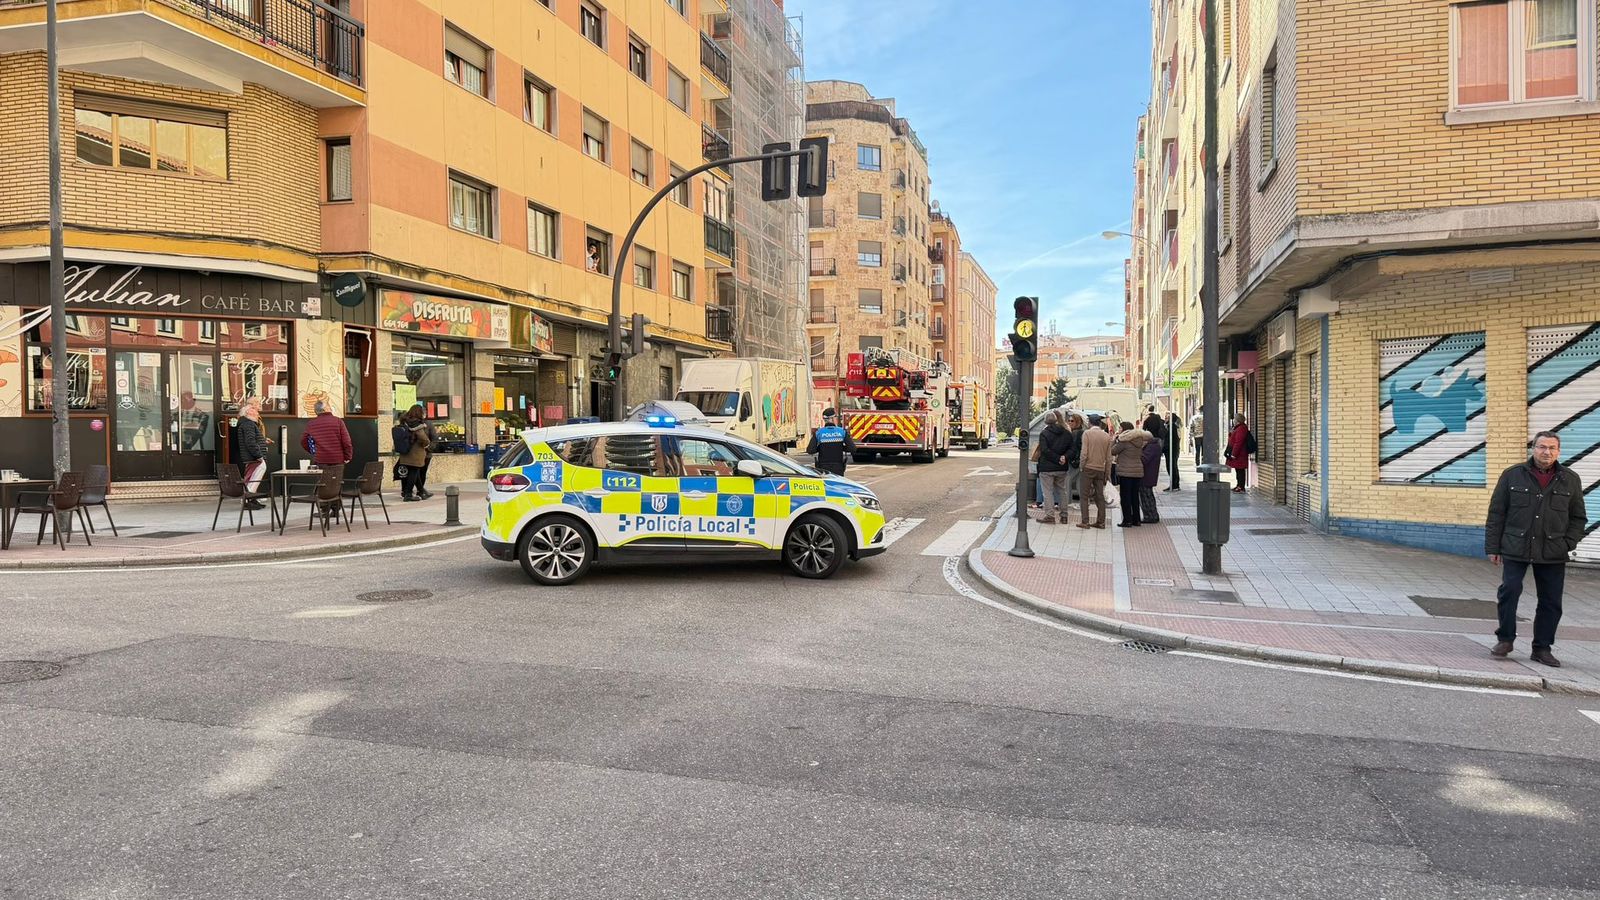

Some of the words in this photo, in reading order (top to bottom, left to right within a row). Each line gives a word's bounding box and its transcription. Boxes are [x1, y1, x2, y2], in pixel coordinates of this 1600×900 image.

[201, 293, 250, 311] CAFÉ
[259, 298, 297, 313] BAR
[412, 300, 473, 324] DISFRUTA
[538, 452, 554, 460] 703
[611, 477, 637, 488] 112
[635, 515, 692, 532] Policía
[699, 516, 740, 533] Local
